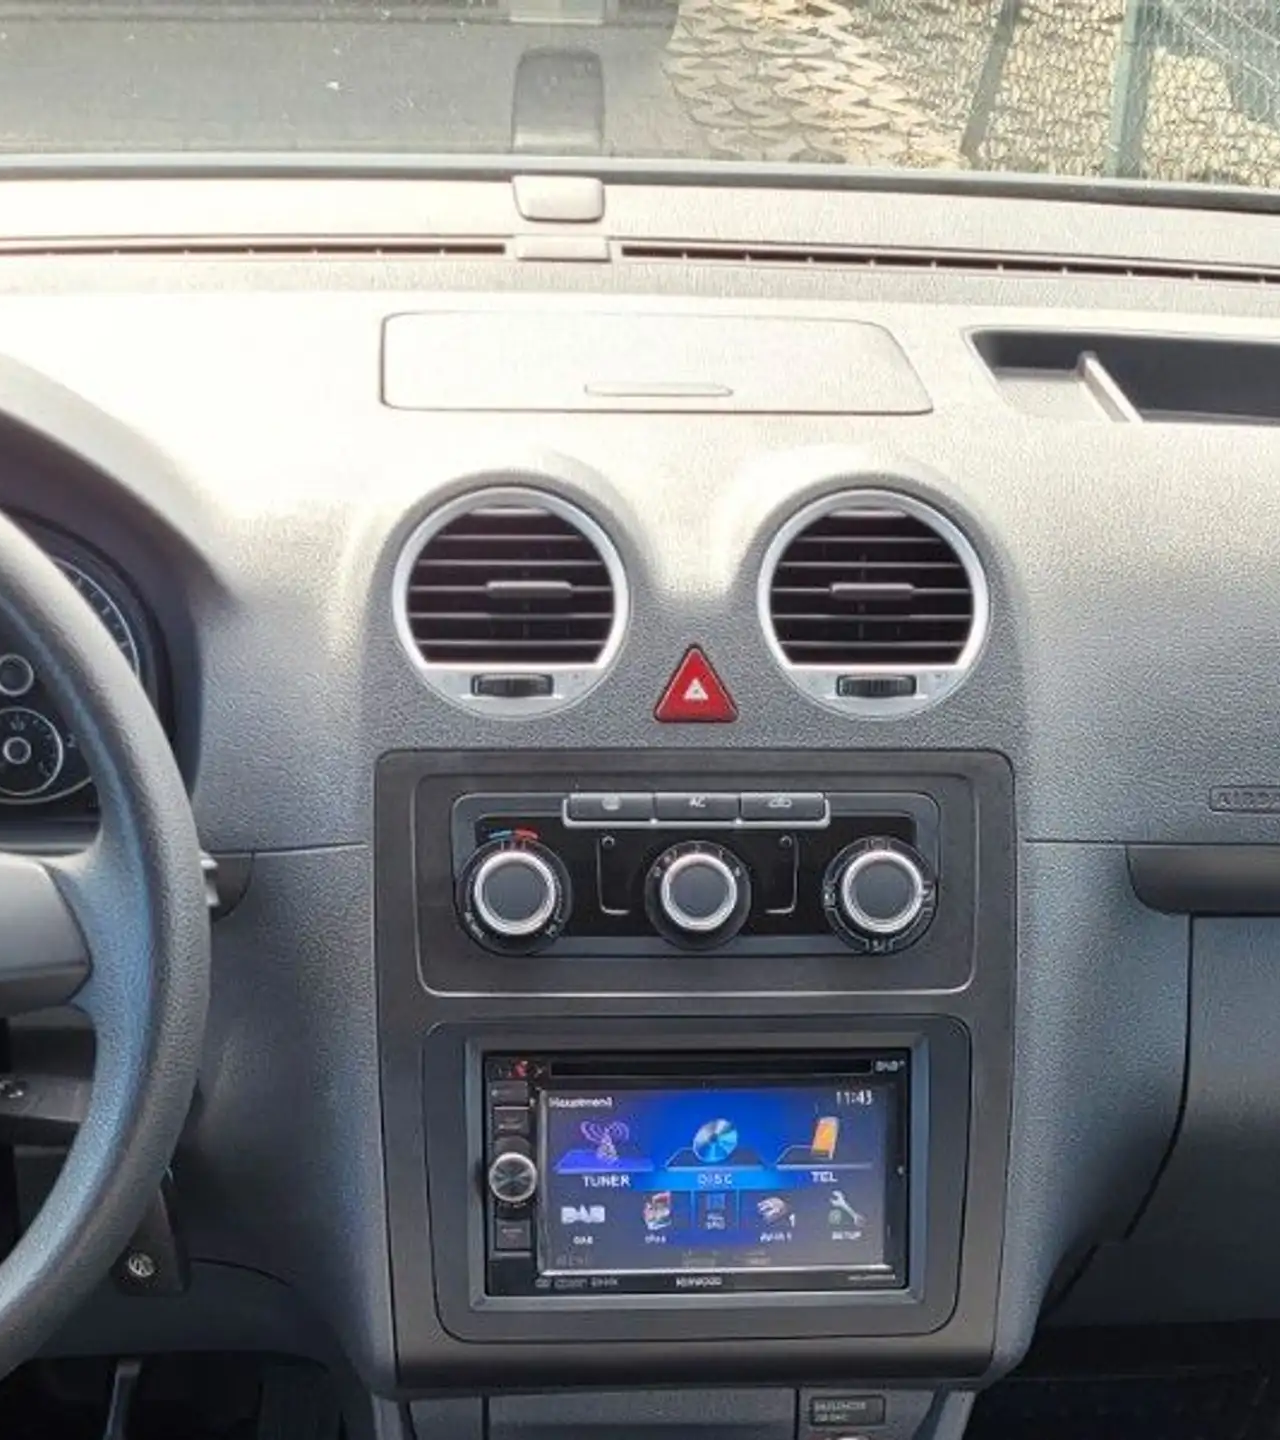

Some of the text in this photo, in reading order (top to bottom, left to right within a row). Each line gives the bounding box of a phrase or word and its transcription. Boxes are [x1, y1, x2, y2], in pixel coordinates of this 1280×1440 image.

[582, 1176, 631, 1188] TUNER
[696, 1174, 732, 1185] DISC
[810, 1171, 838, 1183] TEL
[561, 1205, 606, 1223] DAB
